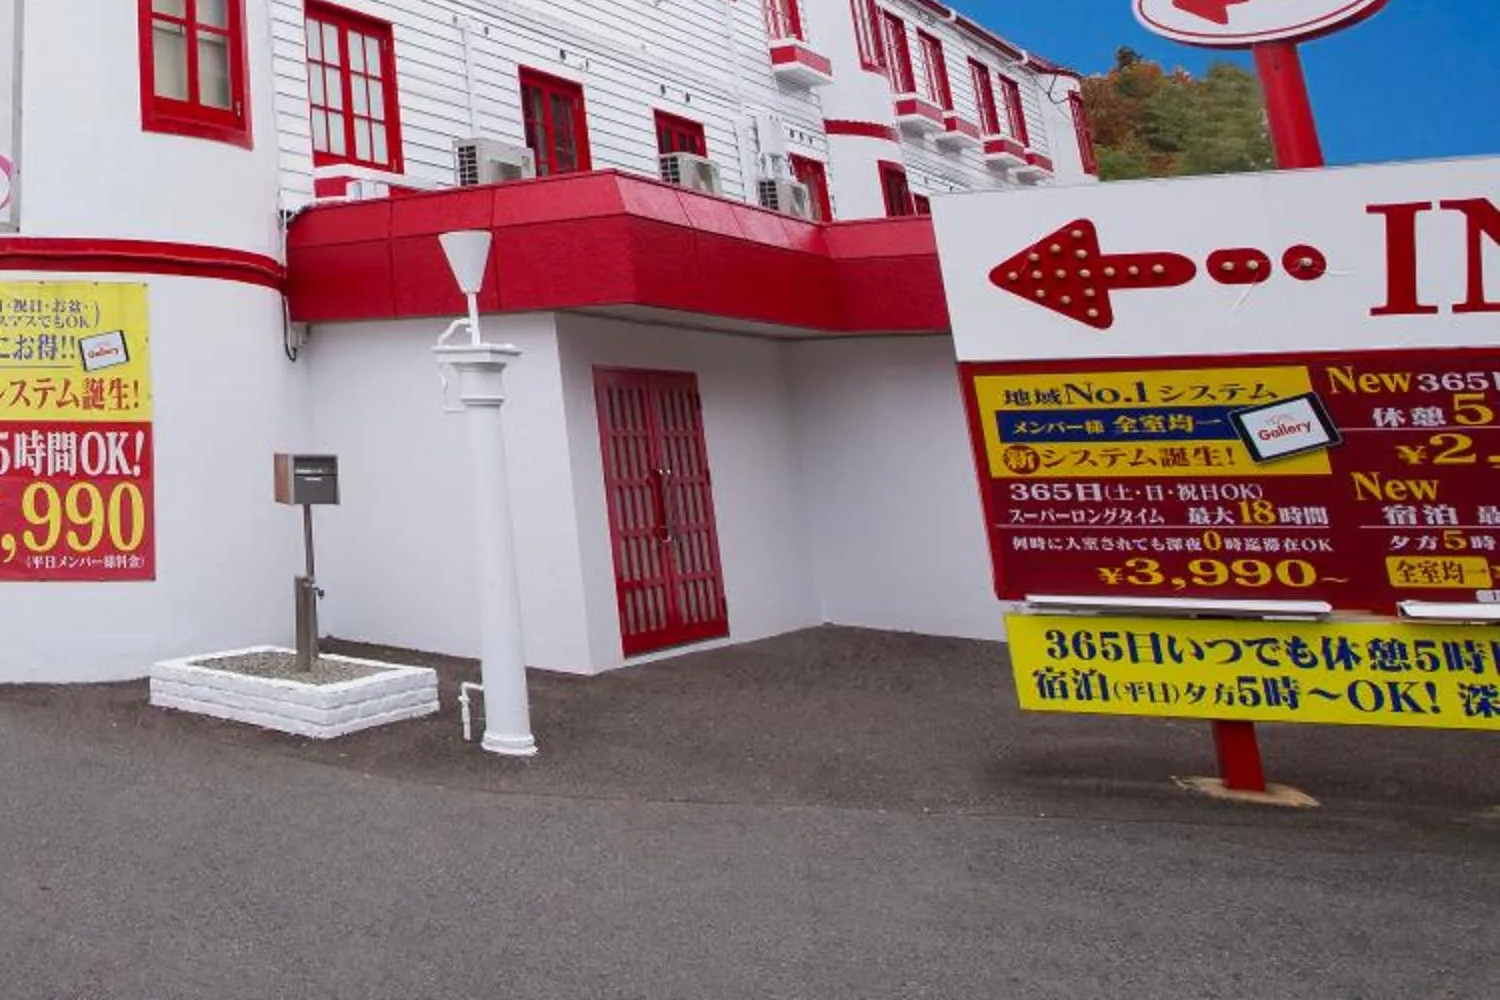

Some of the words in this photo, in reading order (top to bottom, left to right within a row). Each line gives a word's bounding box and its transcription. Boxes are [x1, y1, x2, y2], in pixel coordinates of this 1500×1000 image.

[1326, 366, 1413, 394] New
[1416, 371, 1500, 391] 365
[1258, 421, 1311, 441] Gallery
[1351, 472, 1439, 501] New
[1009, 507, 1165, 524] スーパーロングタイム
[1188, 501, 1328, 526] 最大18時間
[1045, 630, 1500, 676] 365日いつでも休憩5時
